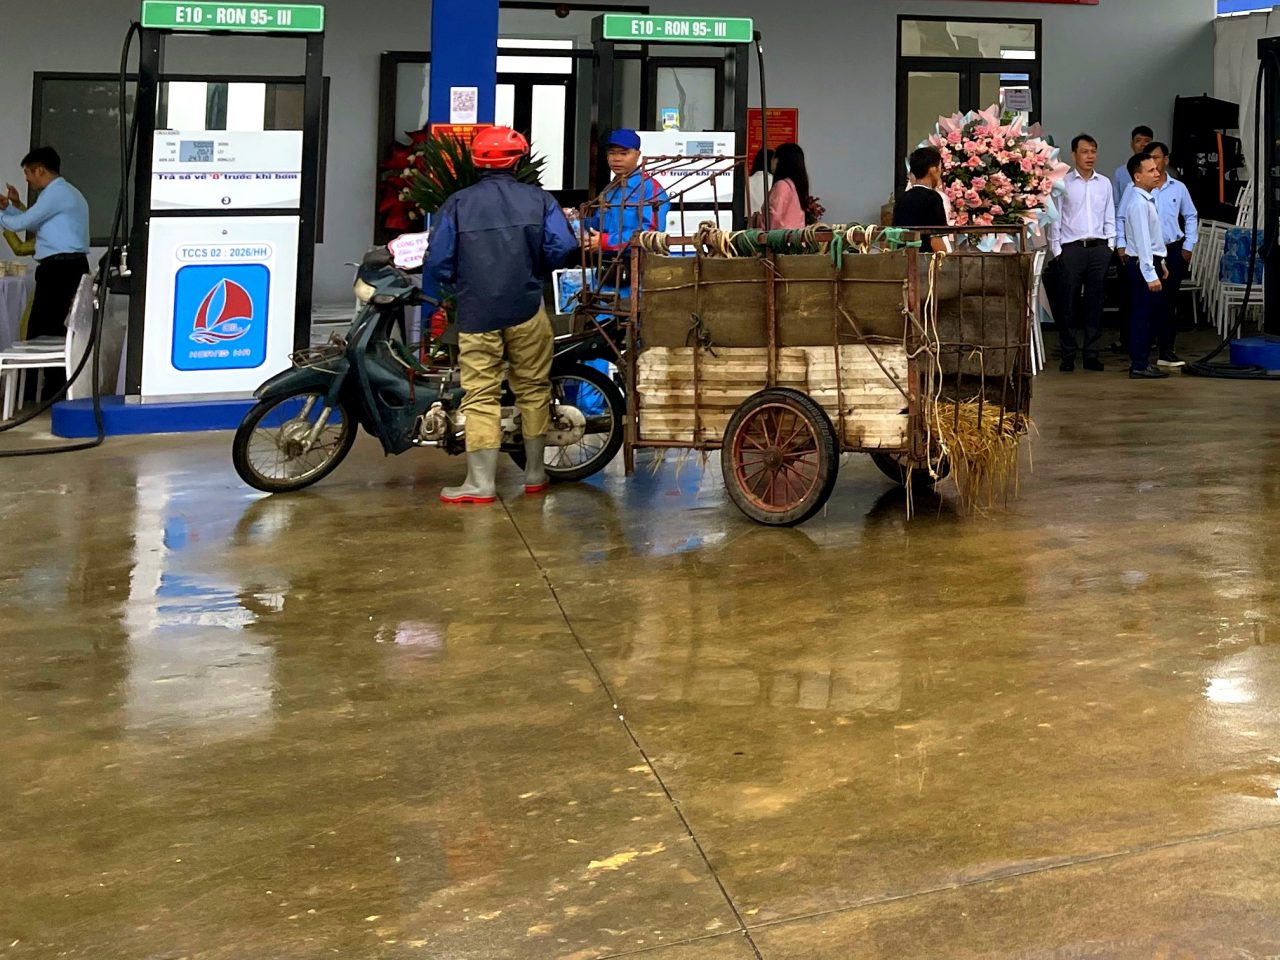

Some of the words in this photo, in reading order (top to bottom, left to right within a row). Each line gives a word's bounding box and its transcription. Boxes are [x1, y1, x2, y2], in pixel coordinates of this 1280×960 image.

[175, 7, 202, 23] E10
[217, 8, 246, 24] RON
[631, 20, 653, 35] E10
[665, 21, 689, 36] RON
[182, 248, 208, 258] TCCS
[210, 248, 221, 257] 02
[230, 248, 267, 257] 2026/HH
